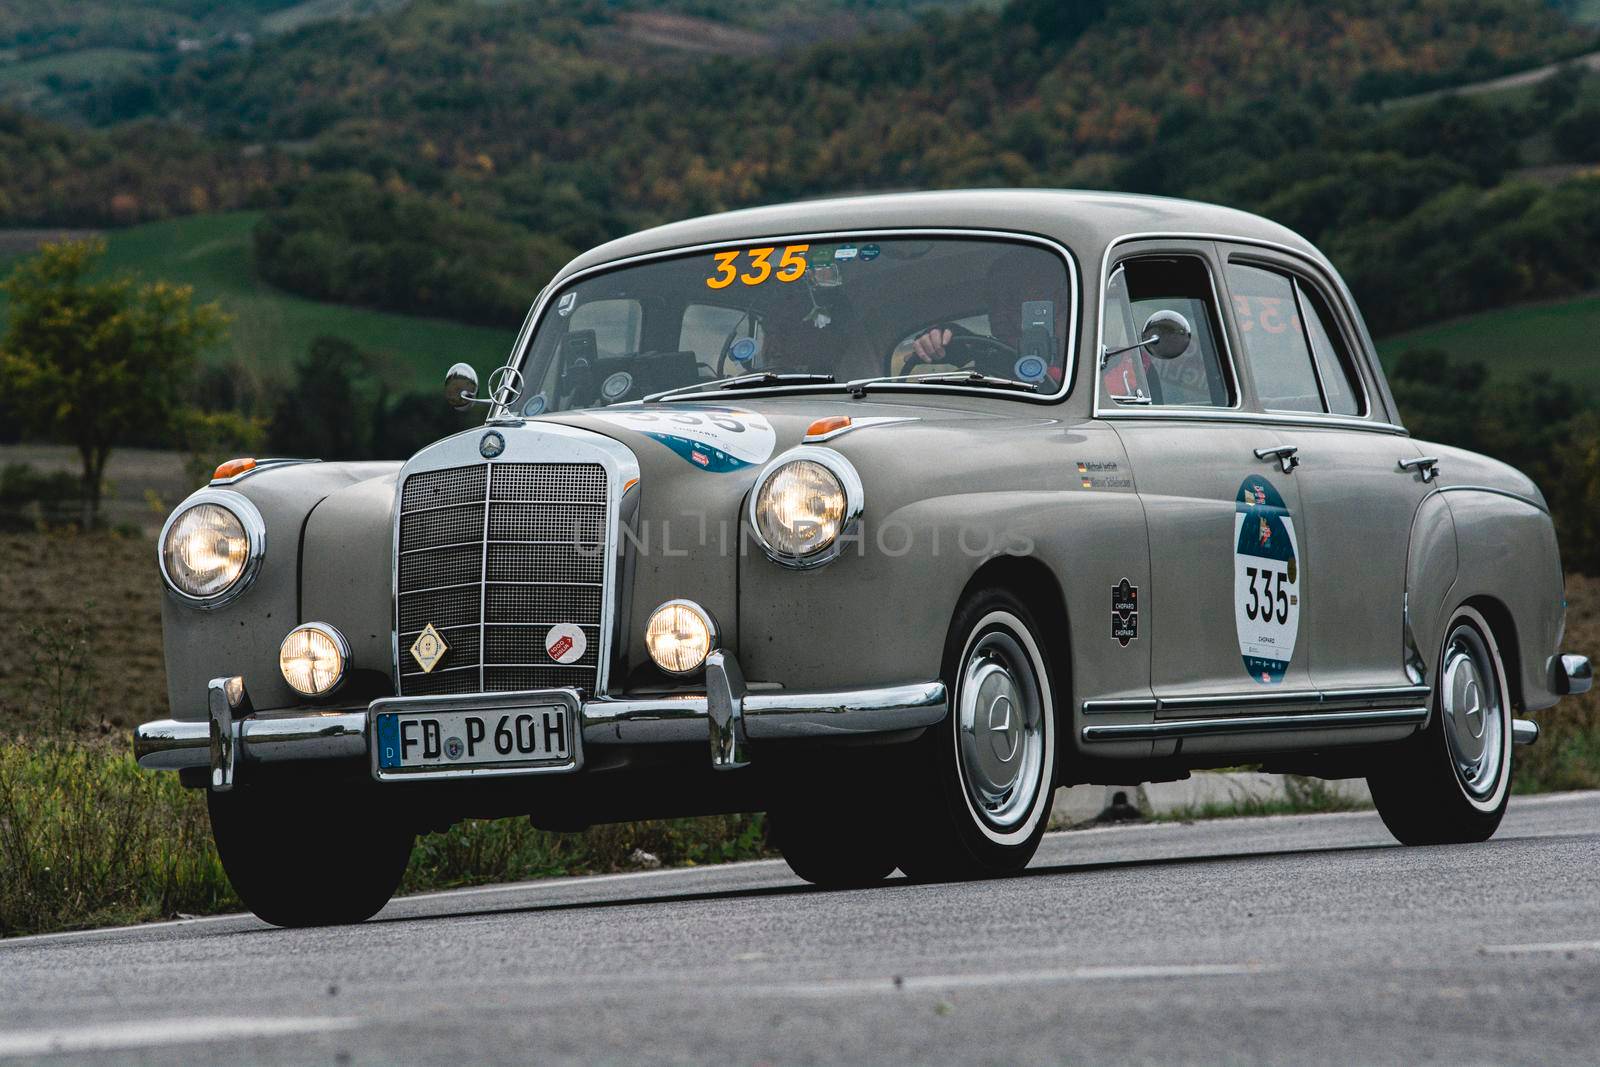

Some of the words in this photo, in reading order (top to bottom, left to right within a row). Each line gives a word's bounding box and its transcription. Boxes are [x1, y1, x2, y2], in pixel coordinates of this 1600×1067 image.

[706, 244, 810, 289] 335
[1115, 602, 1135, 610] CHOPARD
[1246, 566, 1289, 625] 335
[1114, 629, 1134, 637] CHOPARD
[401, 719, 442, 760] FD
[465, 716, 486, 757] P
[386, 747, 394, 758] D
